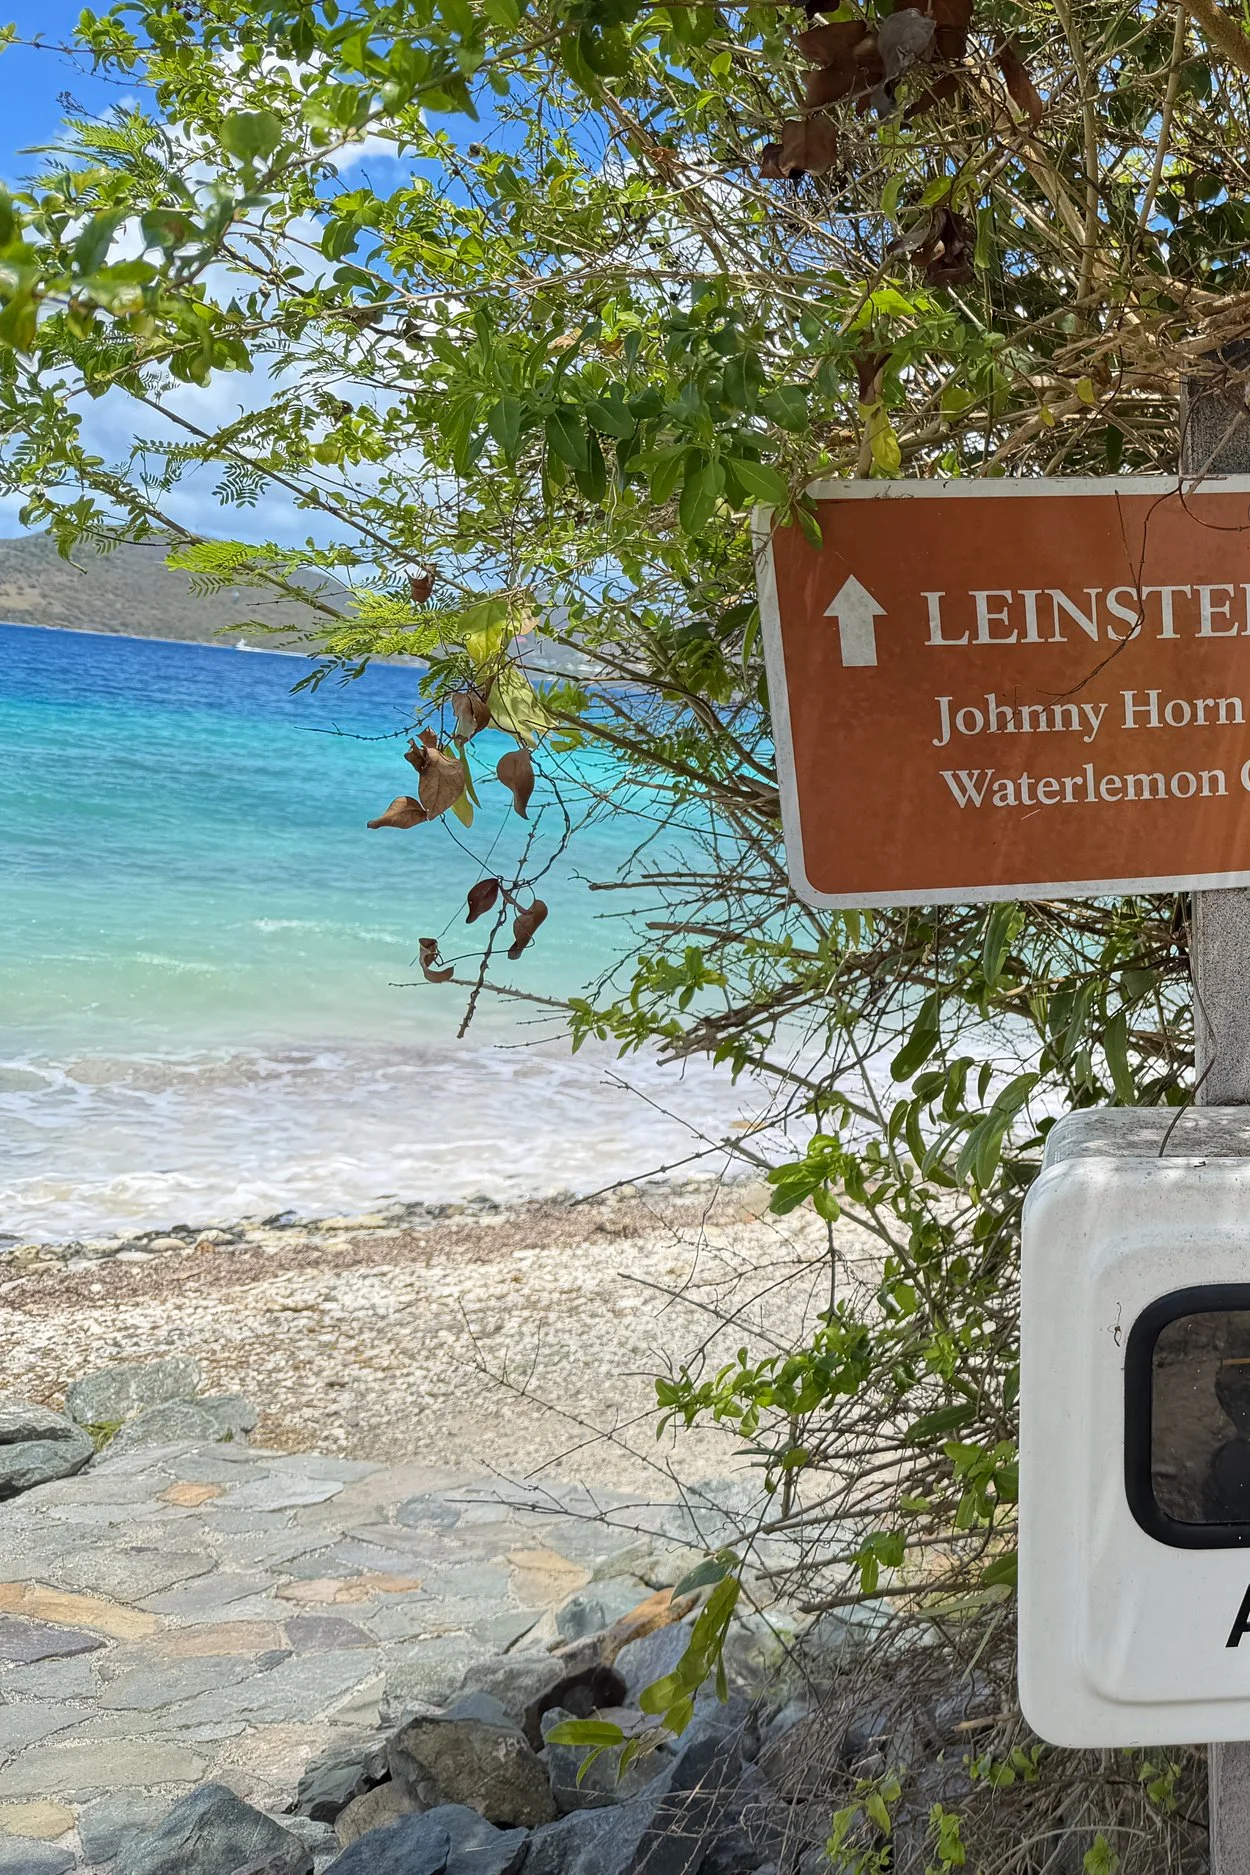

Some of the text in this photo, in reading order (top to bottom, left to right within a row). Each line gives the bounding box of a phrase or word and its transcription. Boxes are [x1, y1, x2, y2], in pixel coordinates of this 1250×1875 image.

[932, 692, 1108, 747] Johnny
[1119, 689, 1246, 728] Horn
[939, 763, 1229, 809] Waterlemon
